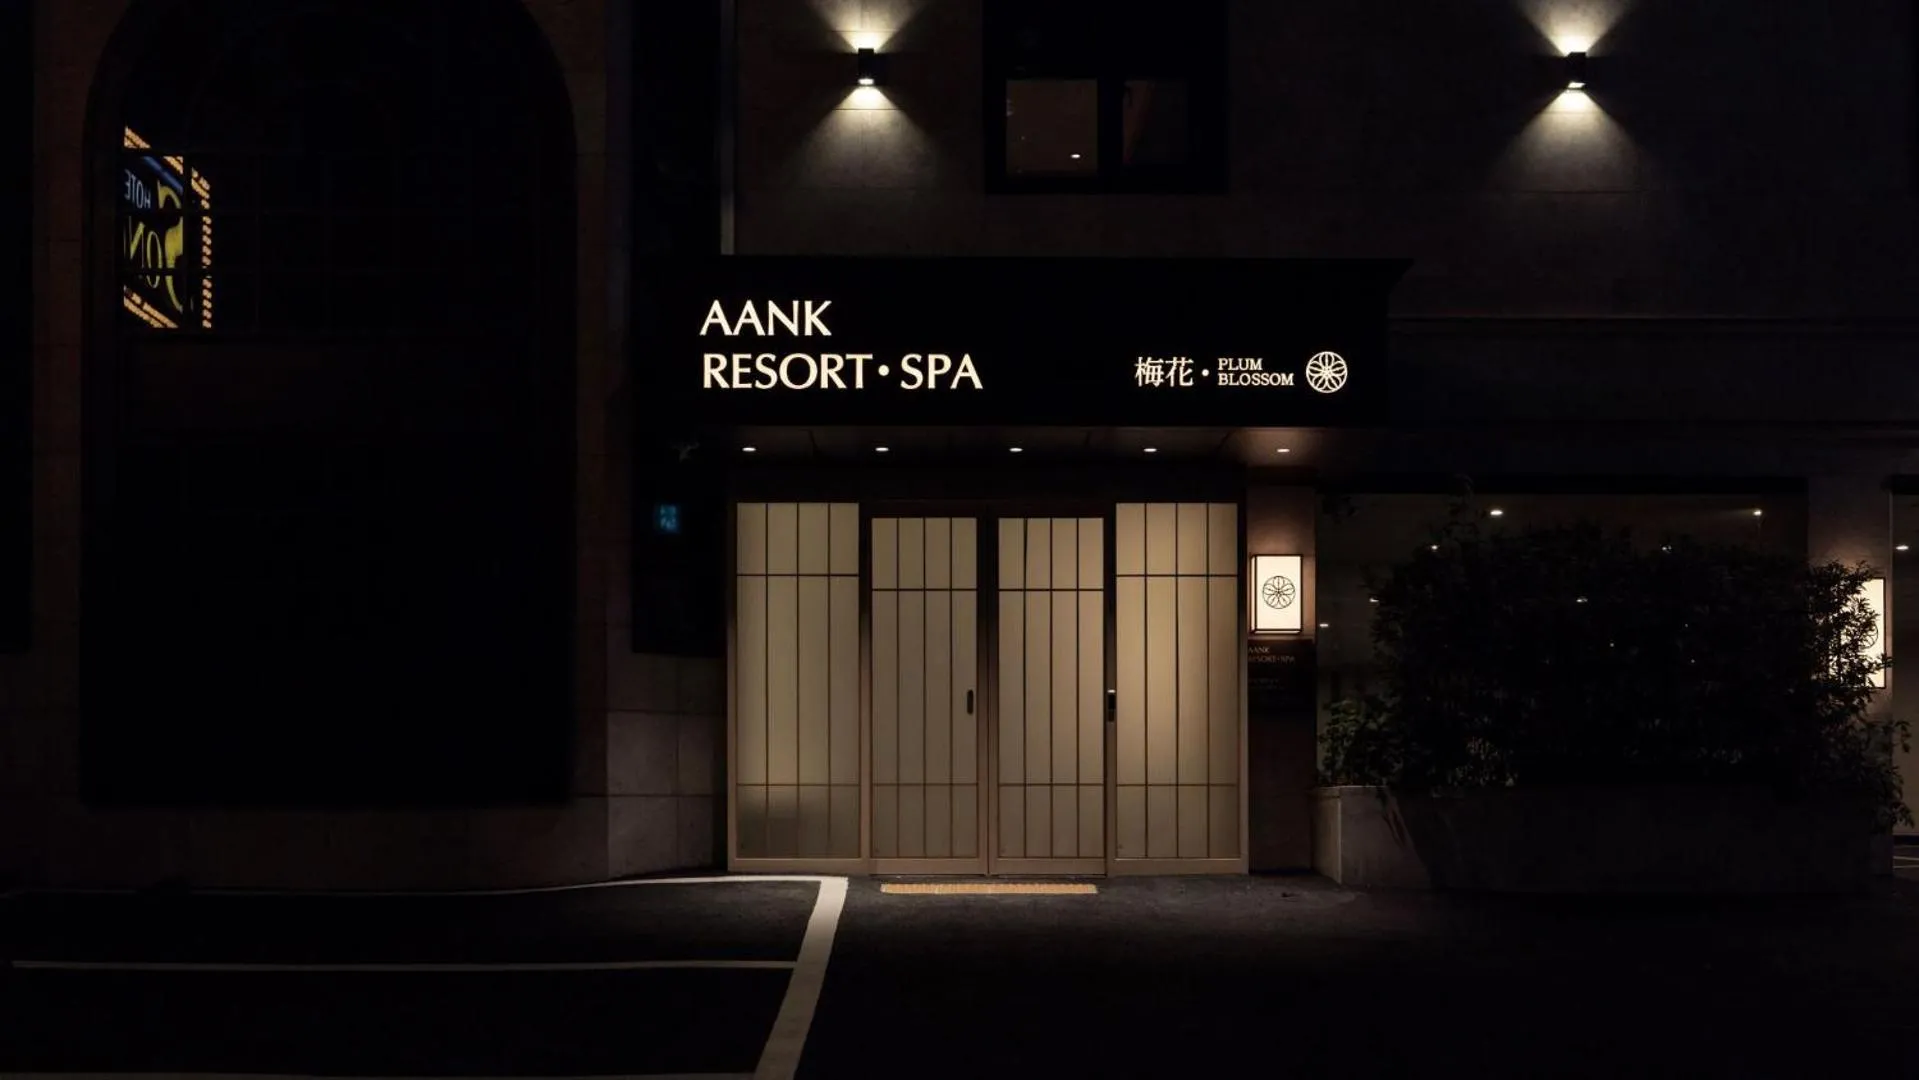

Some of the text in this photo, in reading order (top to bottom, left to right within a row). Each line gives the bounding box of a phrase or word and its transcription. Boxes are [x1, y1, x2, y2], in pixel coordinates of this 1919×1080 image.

[699, 299, 833, 337] AANK
[1135, 356, 1194, 388] 梅花
[1217, 357, 1263, 371] PLUM
[1217, 372, 1295, 386] BLOSSOM
